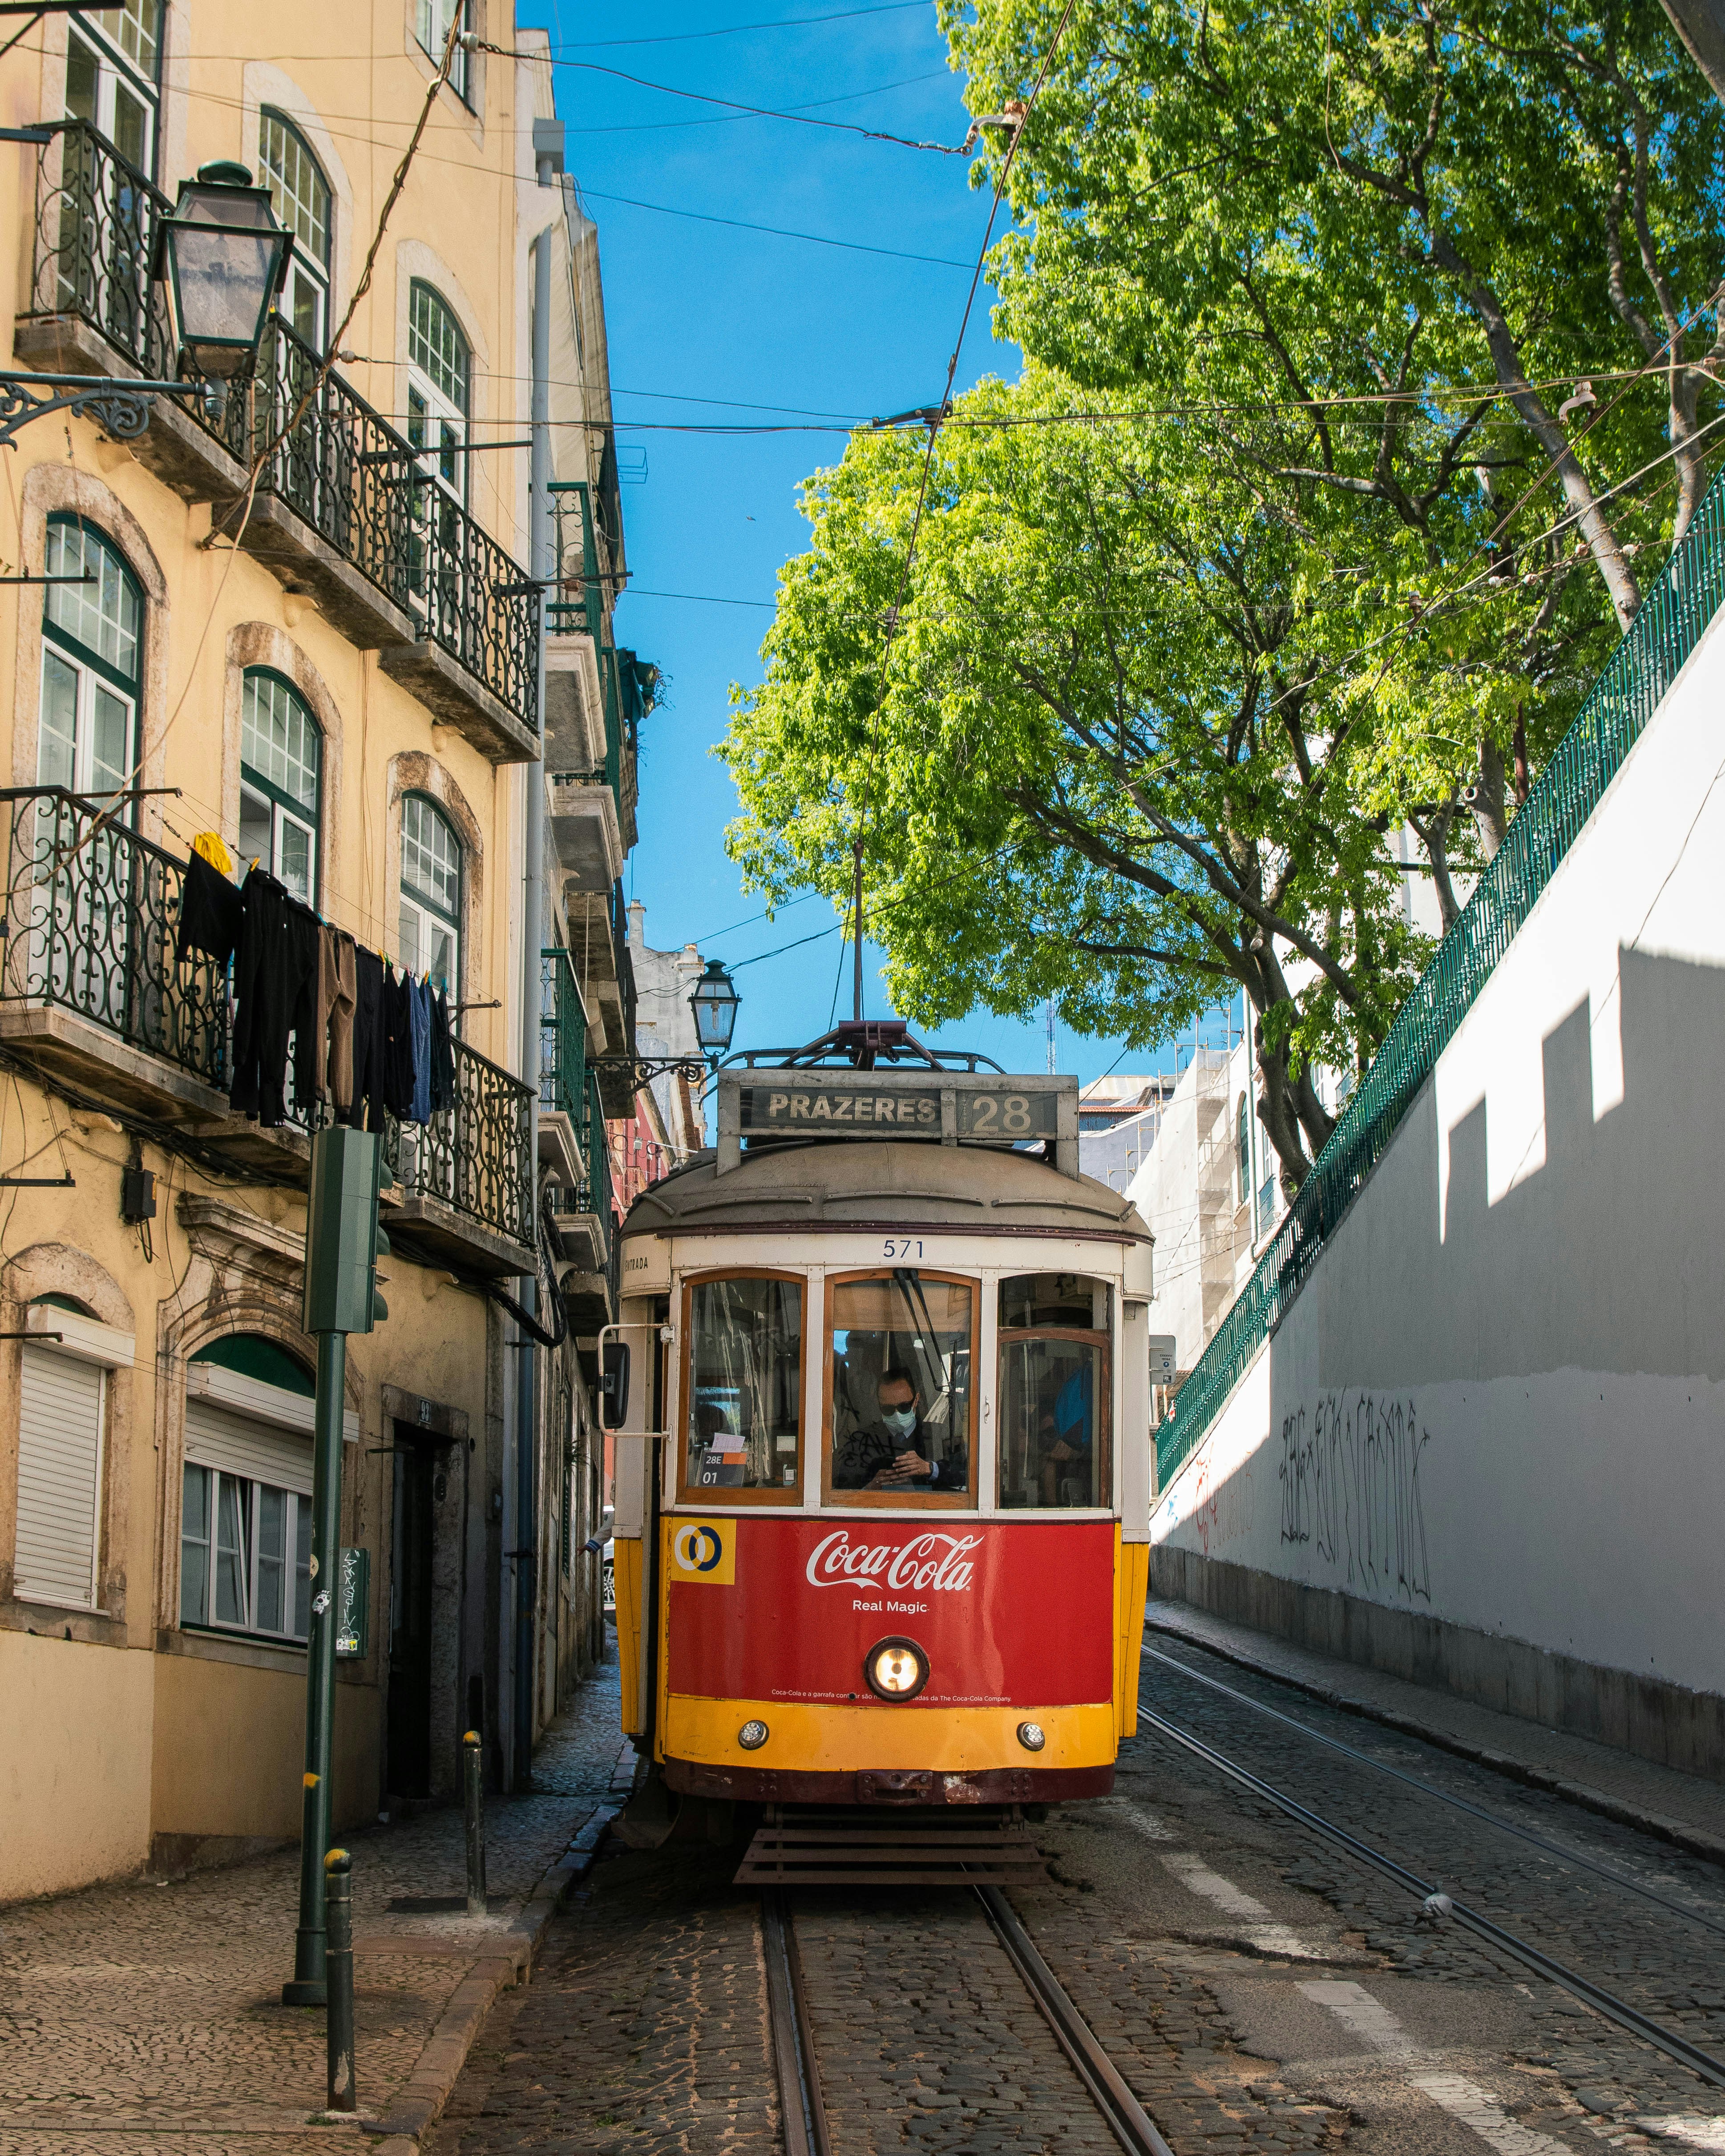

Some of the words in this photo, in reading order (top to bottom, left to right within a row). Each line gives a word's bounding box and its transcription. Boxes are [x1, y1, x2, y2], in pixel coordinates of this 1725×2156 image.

[769, 1093, 936, 1123] PRAZERES
[973, 1095, 1031, 1132] 28
[883, 1239, 922, 1258] 571
[625, 1257, 648, 1272] ENTRADA
[421, 1401, 429, 1421] 93
[706, 1456, 722, 1464] 28E
[703, 1472, 717, 1484] 01
[806, 1530, 986, 1591] Coca-Cola
[853, 1600, 883, 1611] Real
[887, 1601, 927, 1614] Magic
